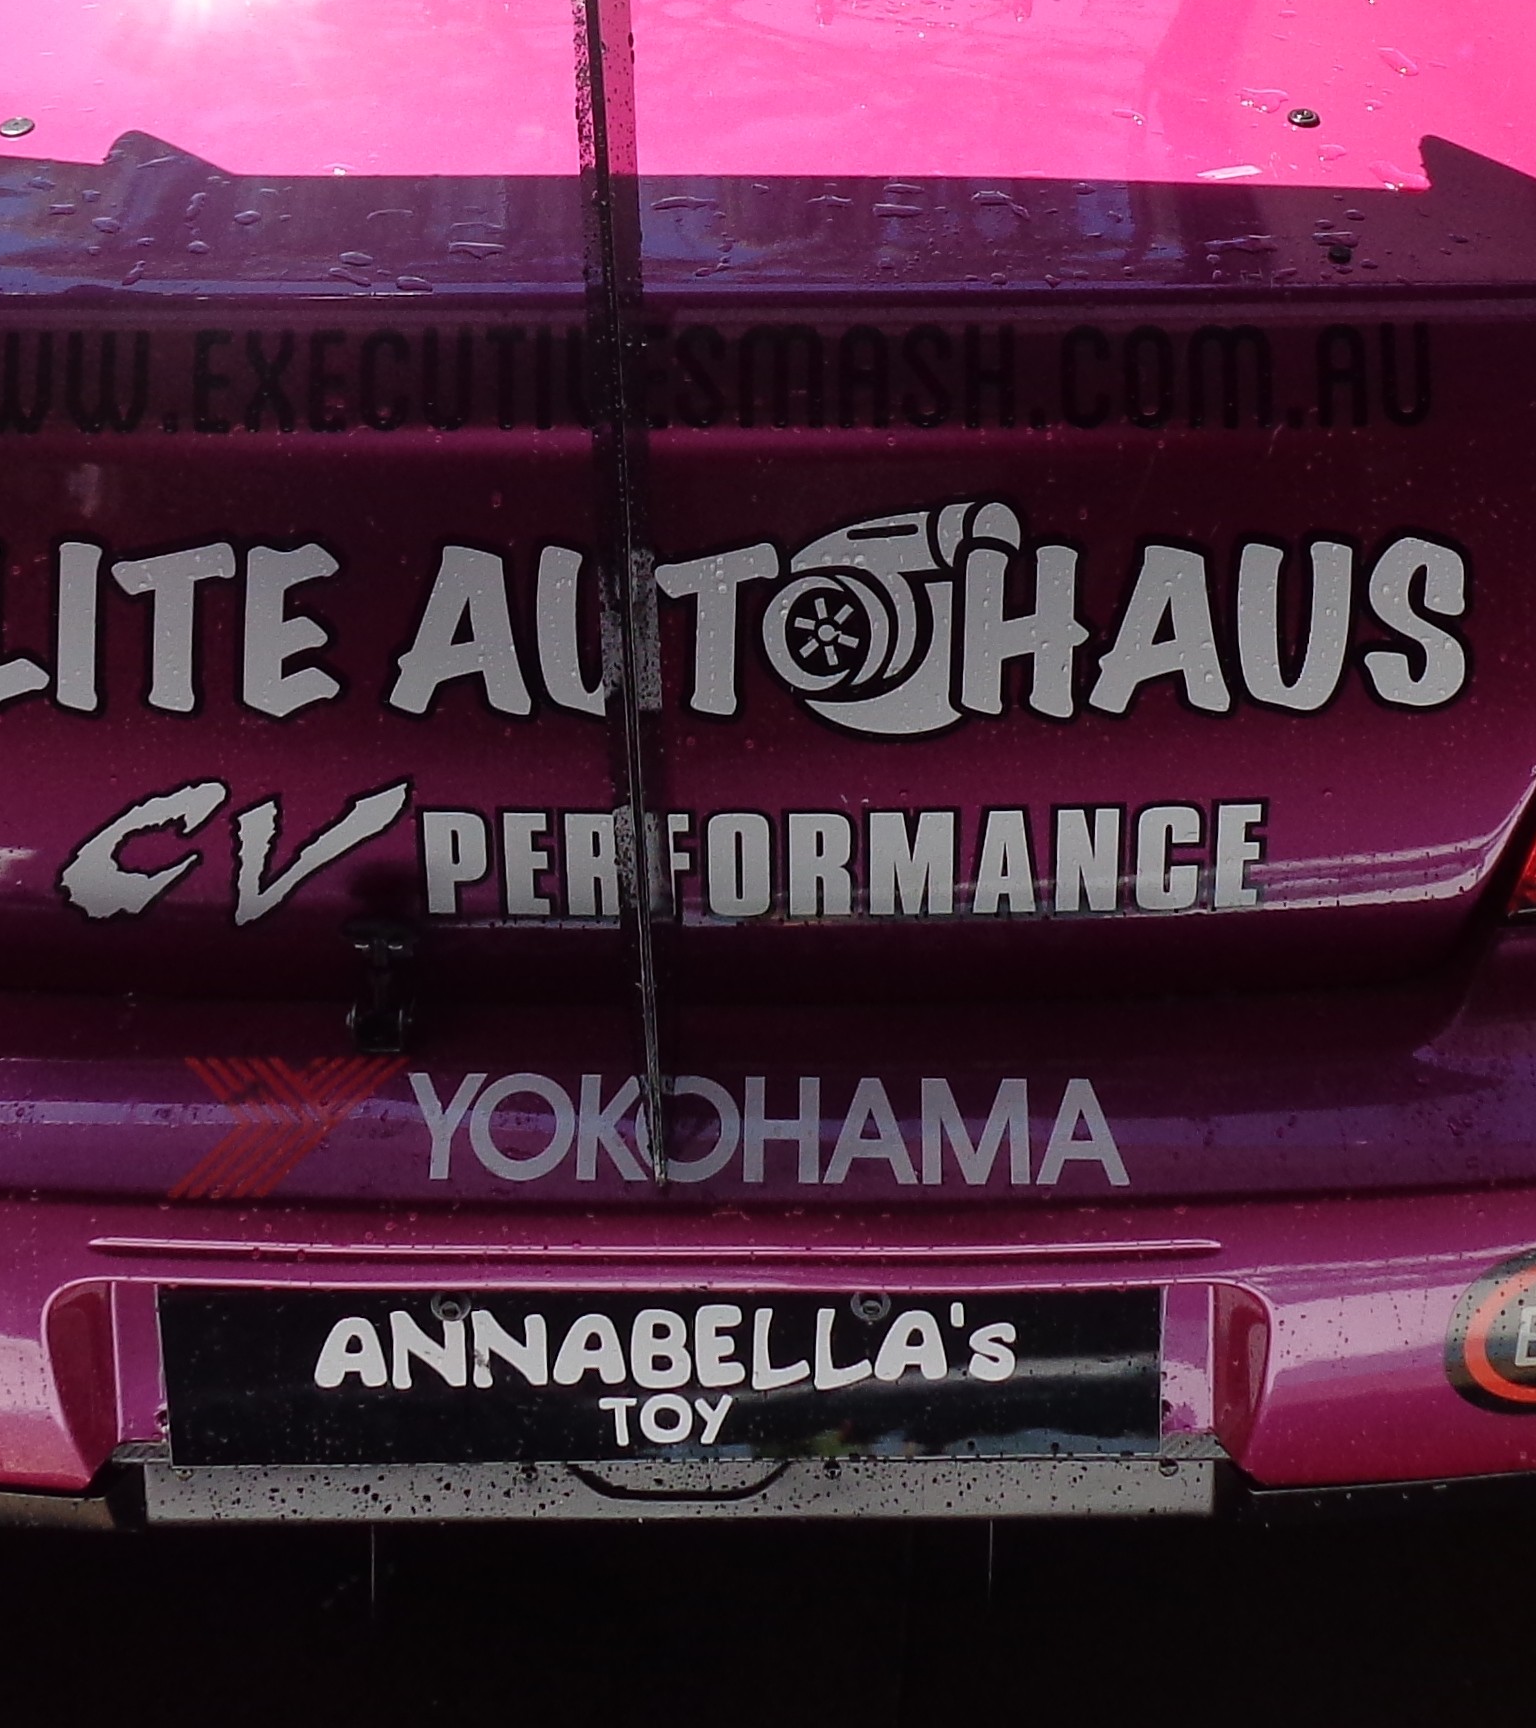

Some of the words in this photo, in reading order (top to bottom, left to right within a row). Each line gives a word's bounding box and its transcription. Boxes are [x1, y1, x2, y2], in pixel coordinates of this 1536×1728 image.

[58, 780, 412, 926] CV
[423, 804, 1268, 916] PERFORMANCE
[408, 1072, 1130, 1186] YOKOHAMA
[314, 1302, 1017, 1391] ANNABELLA's
[597, 1394, 735, 1446] TOY
